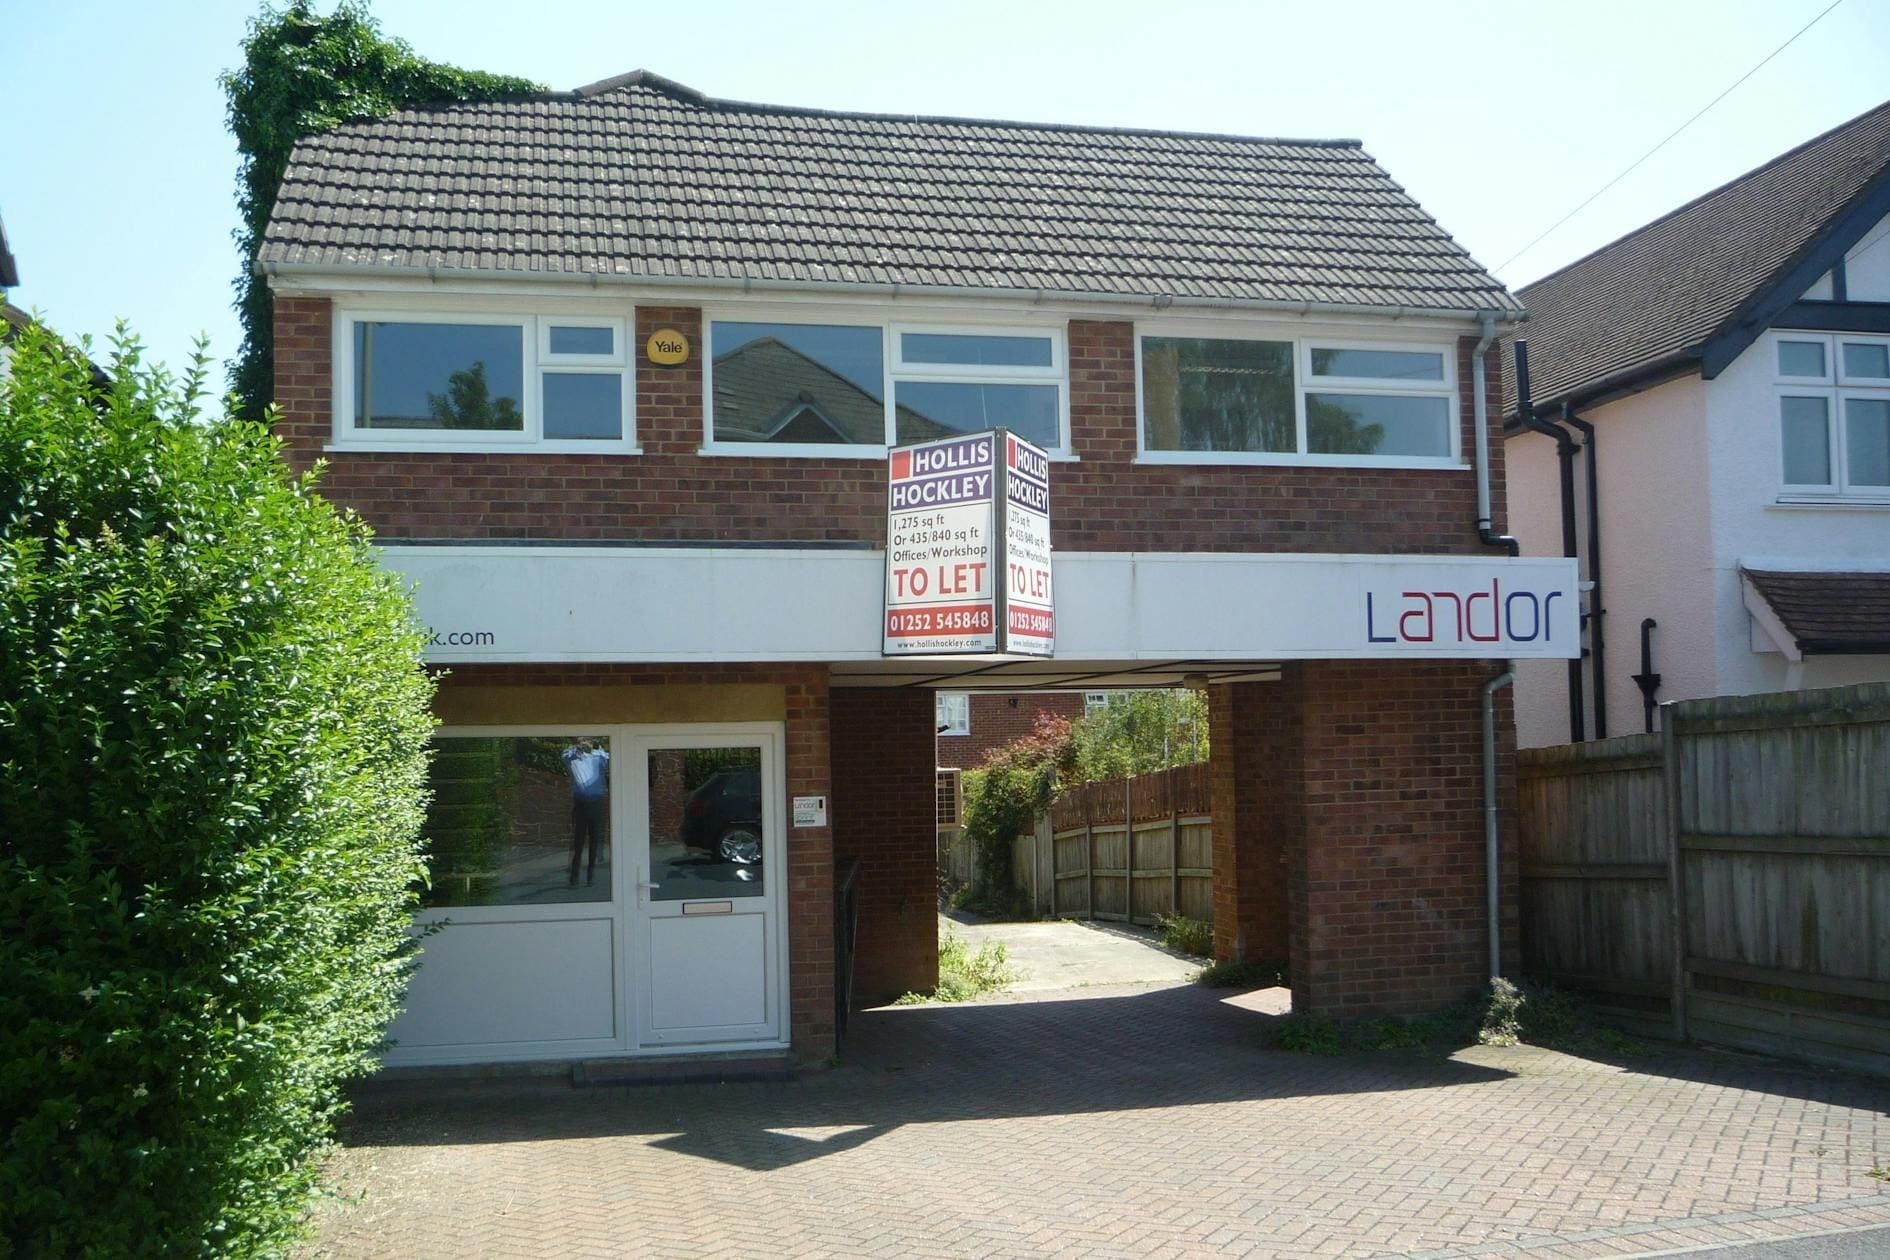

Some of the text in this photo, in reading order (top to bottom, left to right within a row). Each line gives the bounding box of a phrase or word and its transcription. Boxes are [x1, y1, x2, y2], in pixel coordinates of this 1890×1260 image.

[655, 340, 682, 353] Yale
[915, 441, 989, 473] HOLLIS
[1017, 446, 1046, 480] HOLLIS
[892, 474, 989, 507] HOCKLEY
[1008, 474, 1047, 510] HOCKLEY
[893, 513, 944, 531] 1,275 sq ft
[893, 527, 979, 546] Or 435/840 sq ft
[893, 544, 988, 562] Offices/Workshop
[893, 562, 987, 597] TO LET
[1009, 562, 1049, 599] TO LET
[890, 611, 989, 631] 01252 545848
[1009, 610, 1030, 630] 01252
[1366, 577, 1562, 643] Landor
[897, 638, 982, 649] www.hollishockley.com
